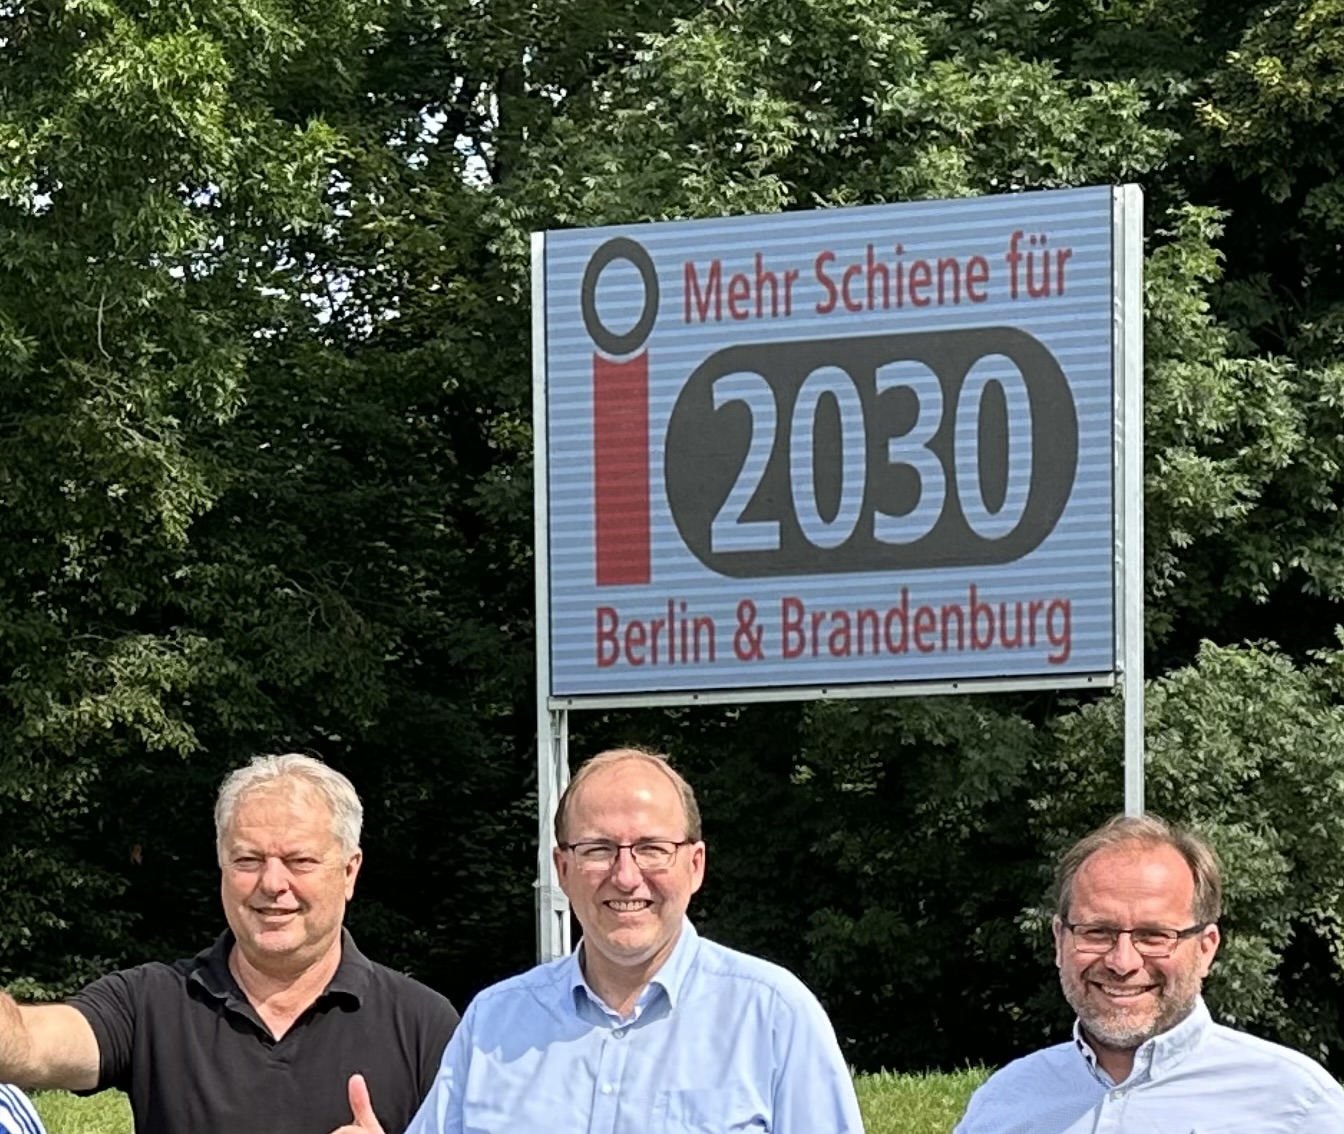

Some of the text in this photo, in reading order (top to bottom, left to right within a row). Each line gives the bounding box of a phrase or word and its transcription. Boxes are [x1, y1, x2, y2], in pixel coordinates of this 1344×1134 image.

[684, 231, 1073, 324] Mehr Schiene für
[710, 353, 1033, 553] 2030
[596, 584, 1072, 668] Berlin & Brandenburg
